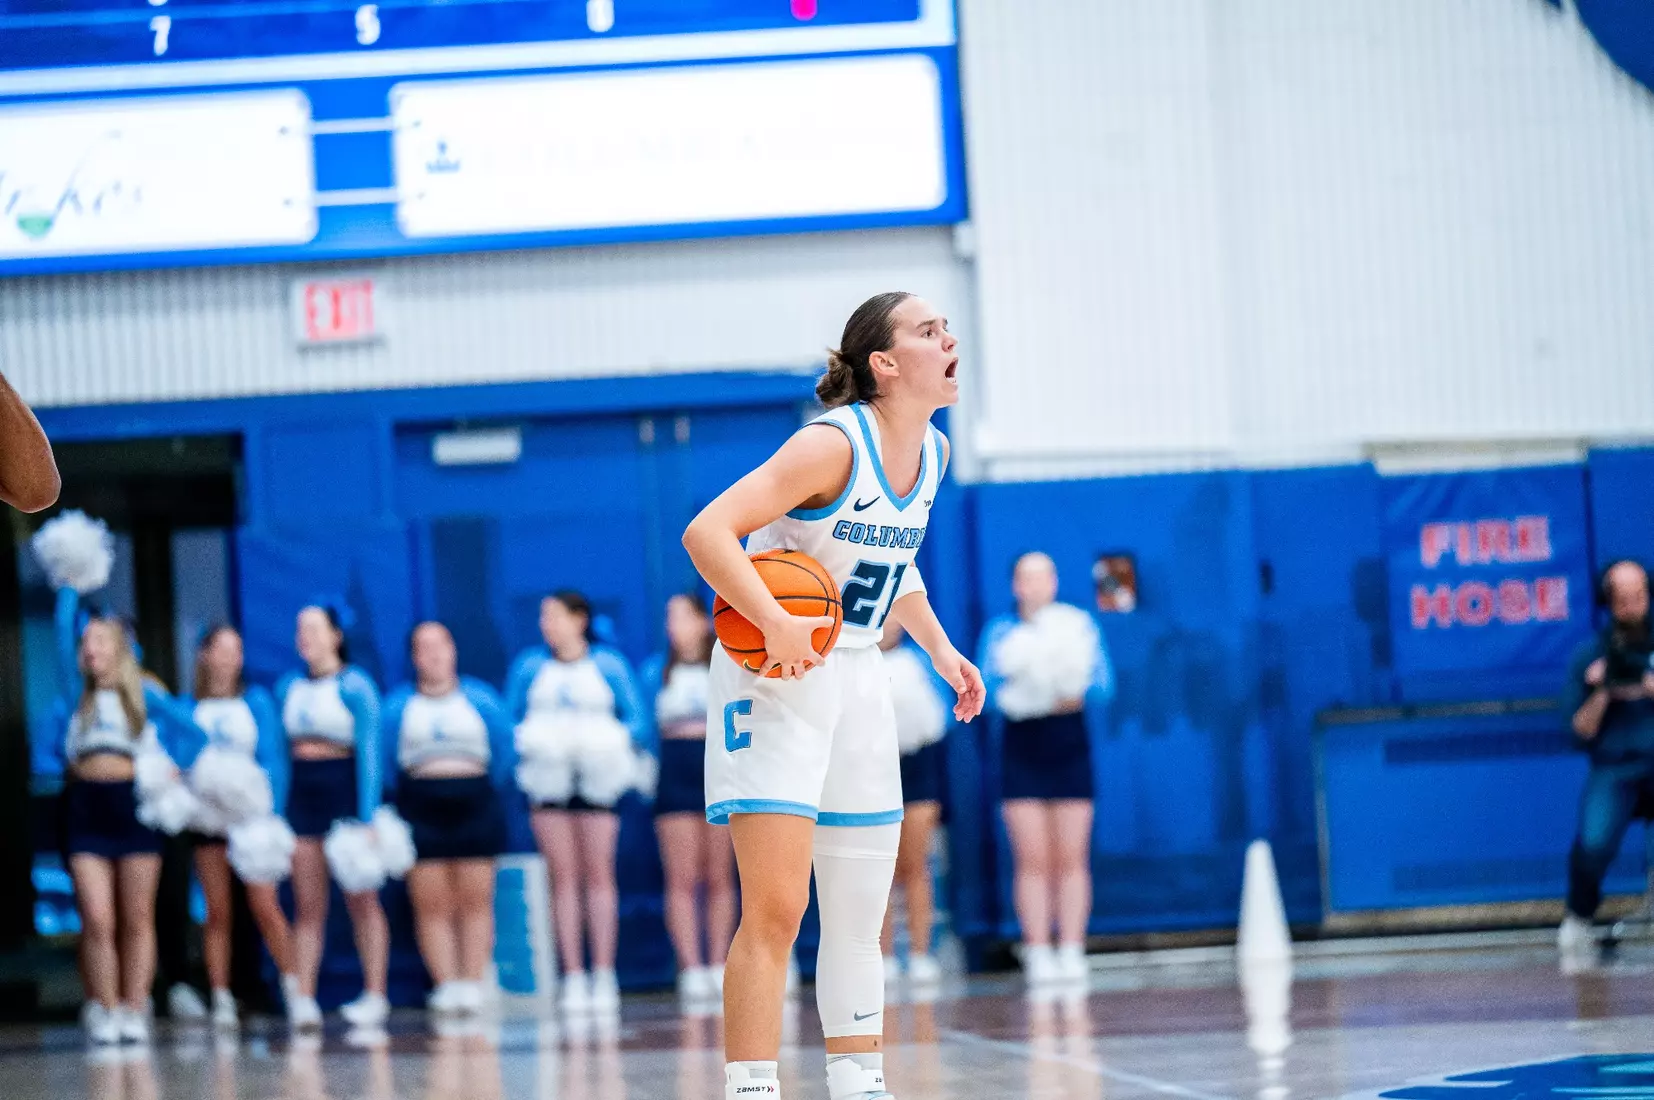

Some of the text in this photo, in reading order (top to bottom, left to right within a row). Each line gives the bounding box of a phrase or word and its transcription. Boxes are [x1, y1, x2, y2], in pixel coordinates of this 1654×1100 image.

[149, 15, 172, 56] 7
[304, 279, 375, 341] EXIT
[1420, 515, 1551, 568] FIRE
[1411, 575, 1569, 629] HOSE
[723, 699, 753, 753] C
